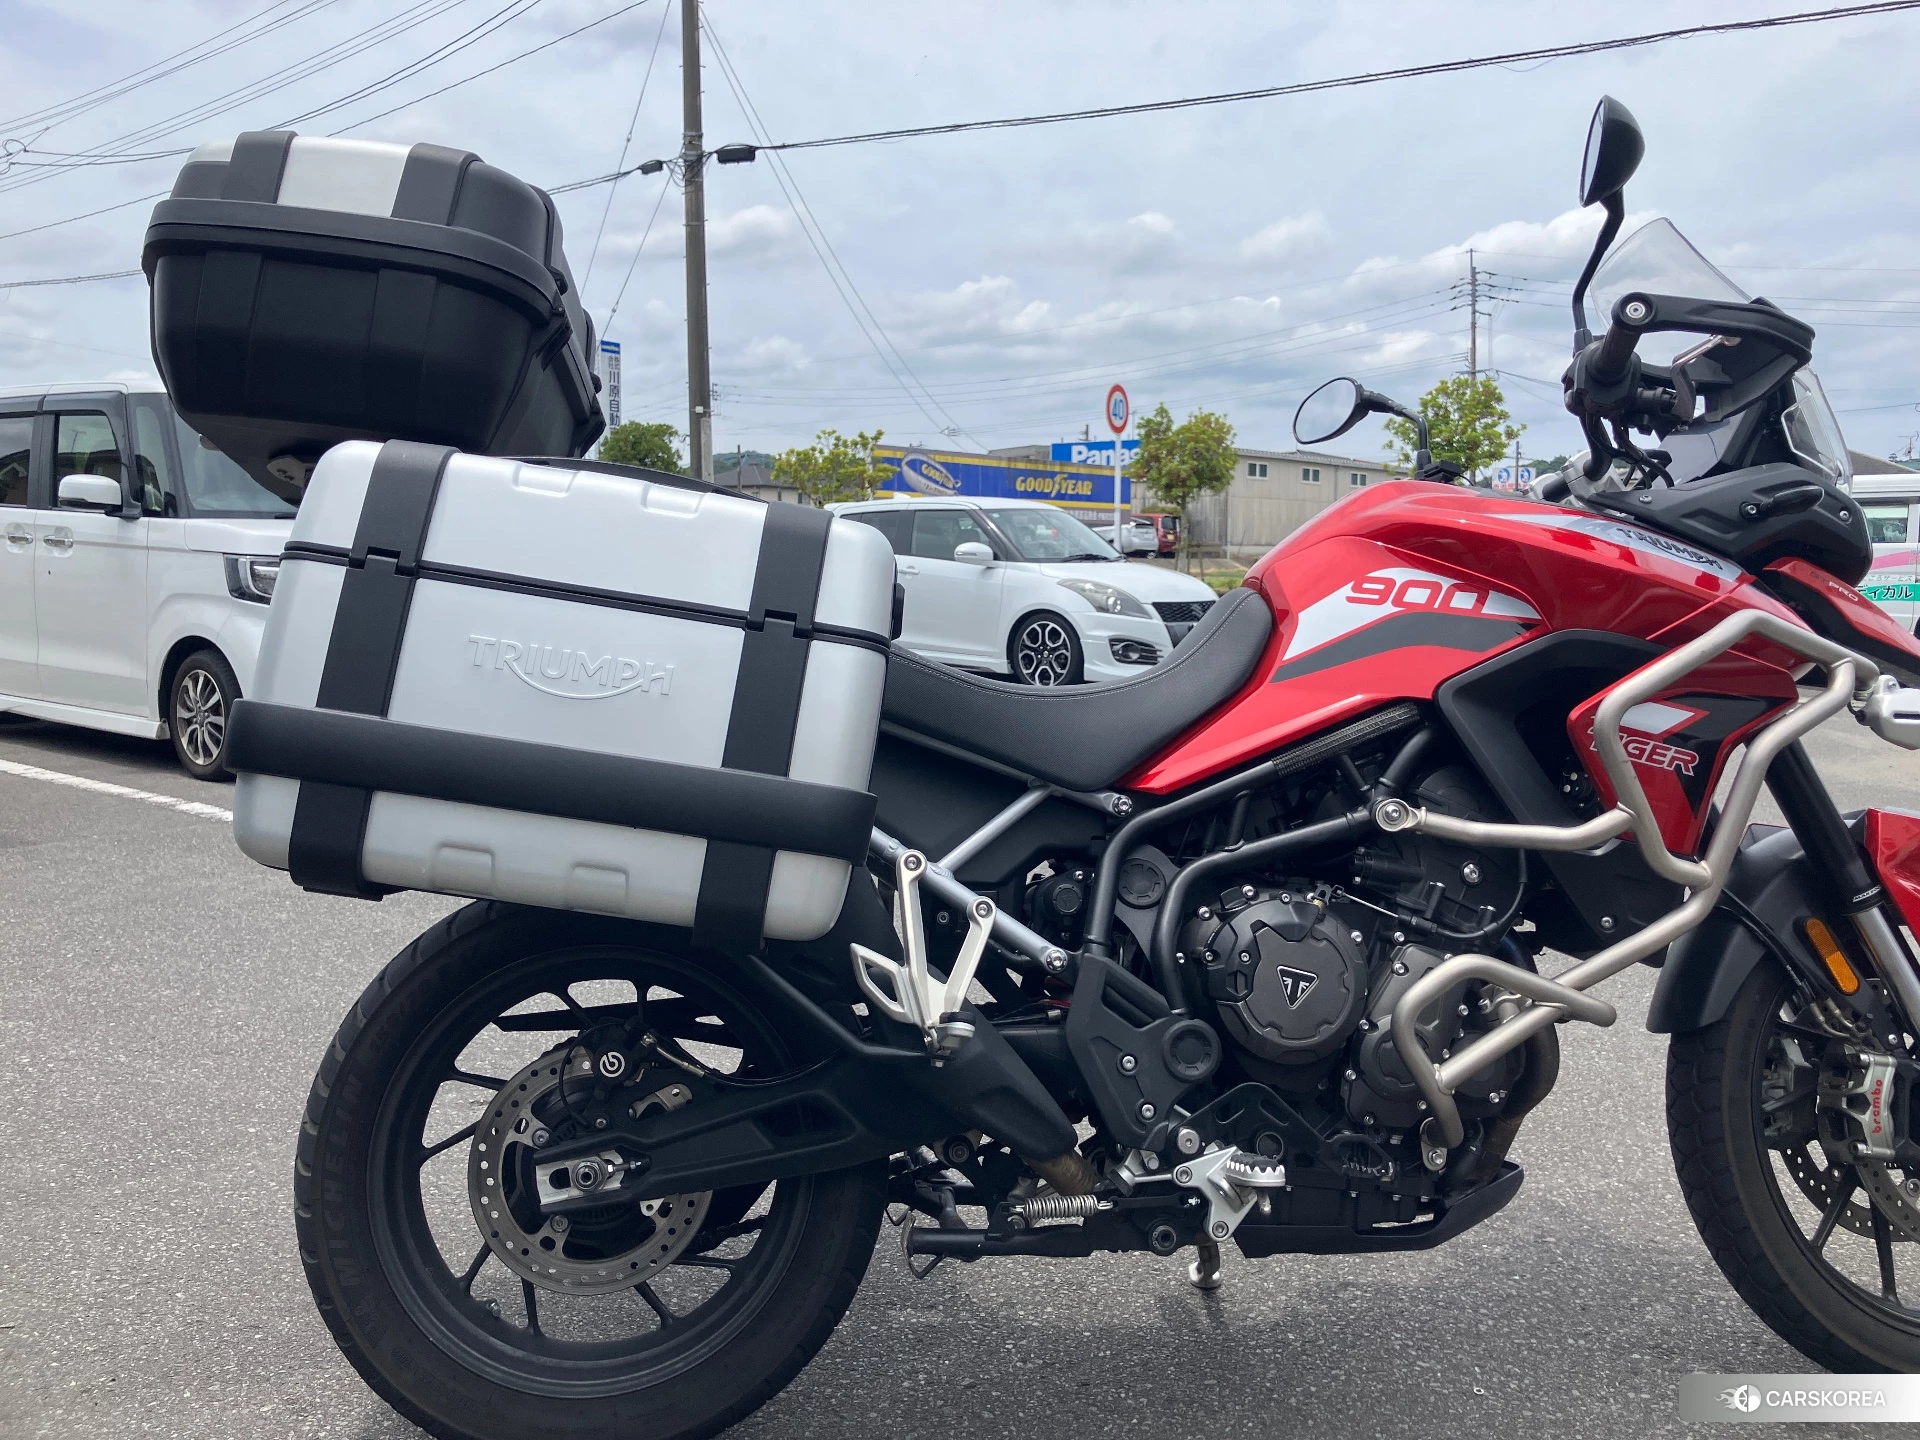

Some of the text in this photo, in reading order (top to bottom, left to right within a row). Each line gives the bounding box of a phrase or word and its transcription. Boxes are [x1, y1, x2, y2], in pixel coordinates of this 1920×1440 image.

[609, 371, 620, 430] 川原自動
[1112, 398, 1124, 420] 40
[1015, 473, 1093, 498] GOODYEAR
[1616, 527, 1723, 570] TRIUMPH
[1345, 577, 1488, 613] 900
[1829, 581, 1859, 602] PRO
[468, 635, 675, 700] TRIUMPH
[1587, 714, 1700, 776] GER
[1871, 1079, 1883, 1134] brembo
